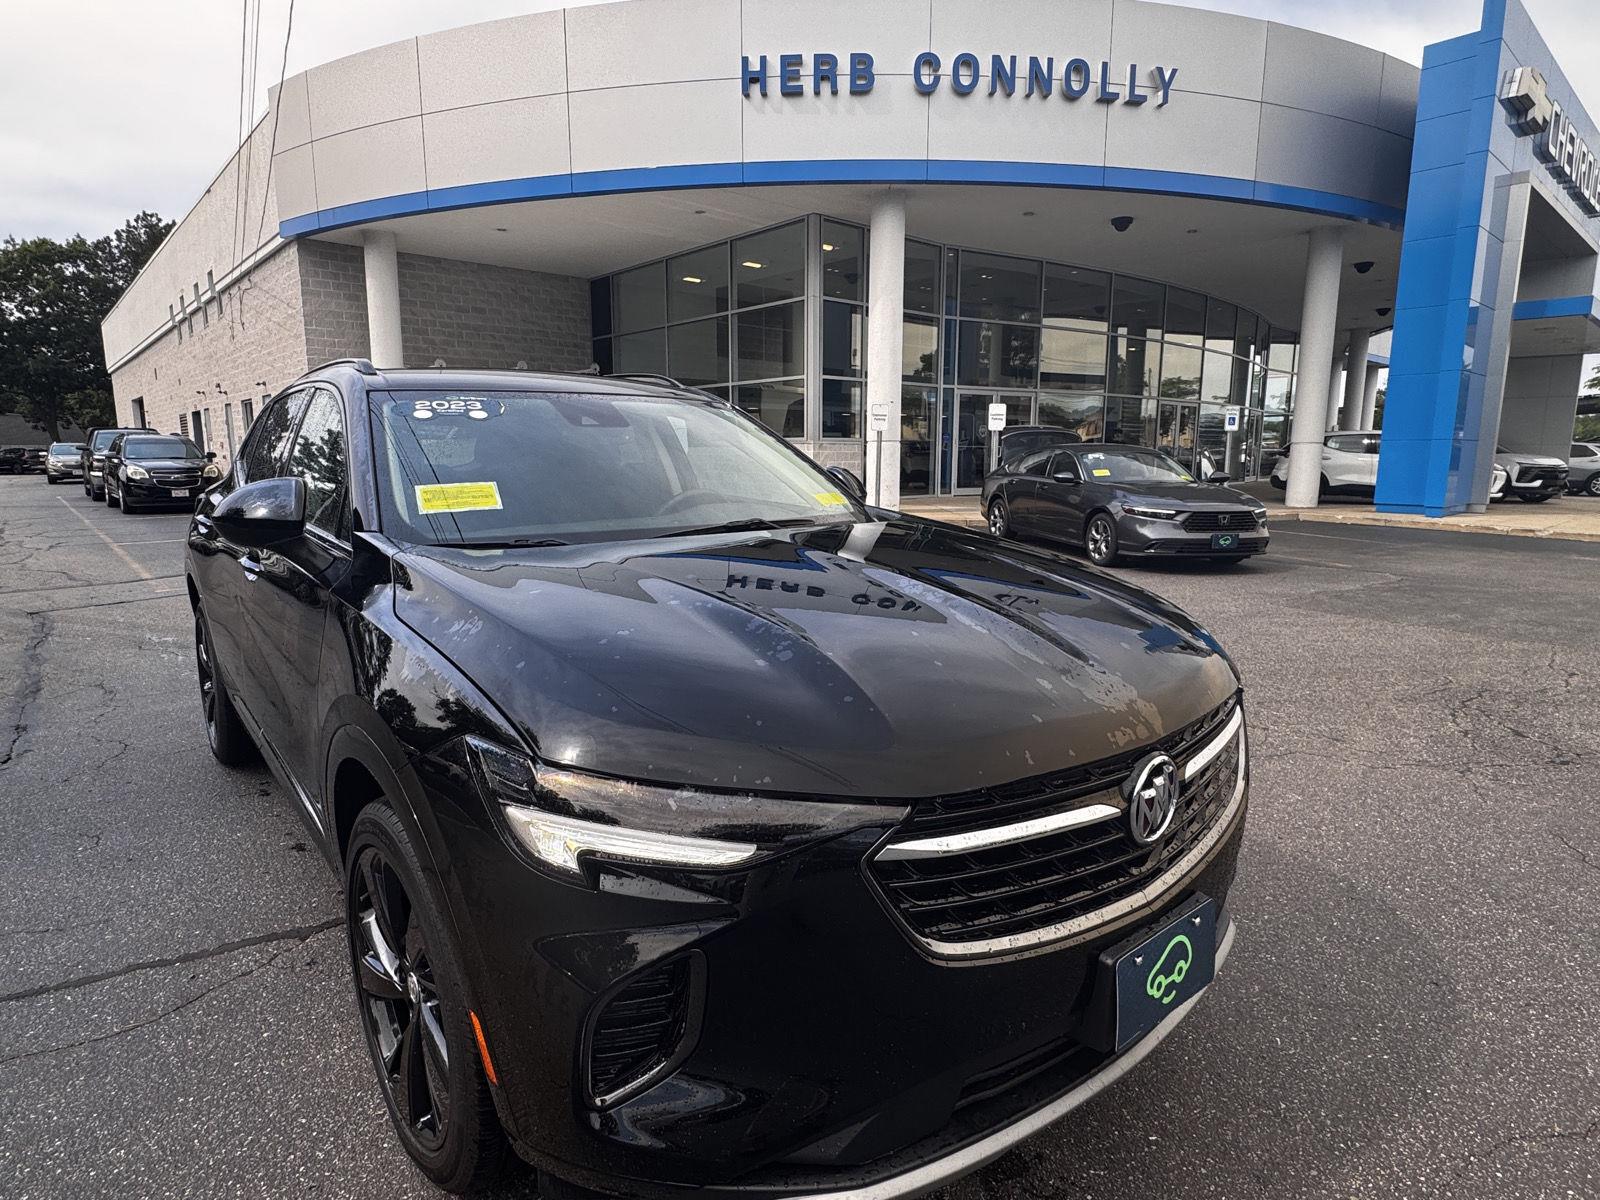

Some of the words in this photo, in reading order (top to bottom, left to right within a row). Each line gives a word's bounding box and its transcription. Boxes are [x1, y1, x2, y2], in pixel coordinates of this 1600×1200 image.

[741, 52, 876, 97] HERB
[913, 51, 1179, 108] CONNOLLY
[415, 400, 483, 410] 2023
